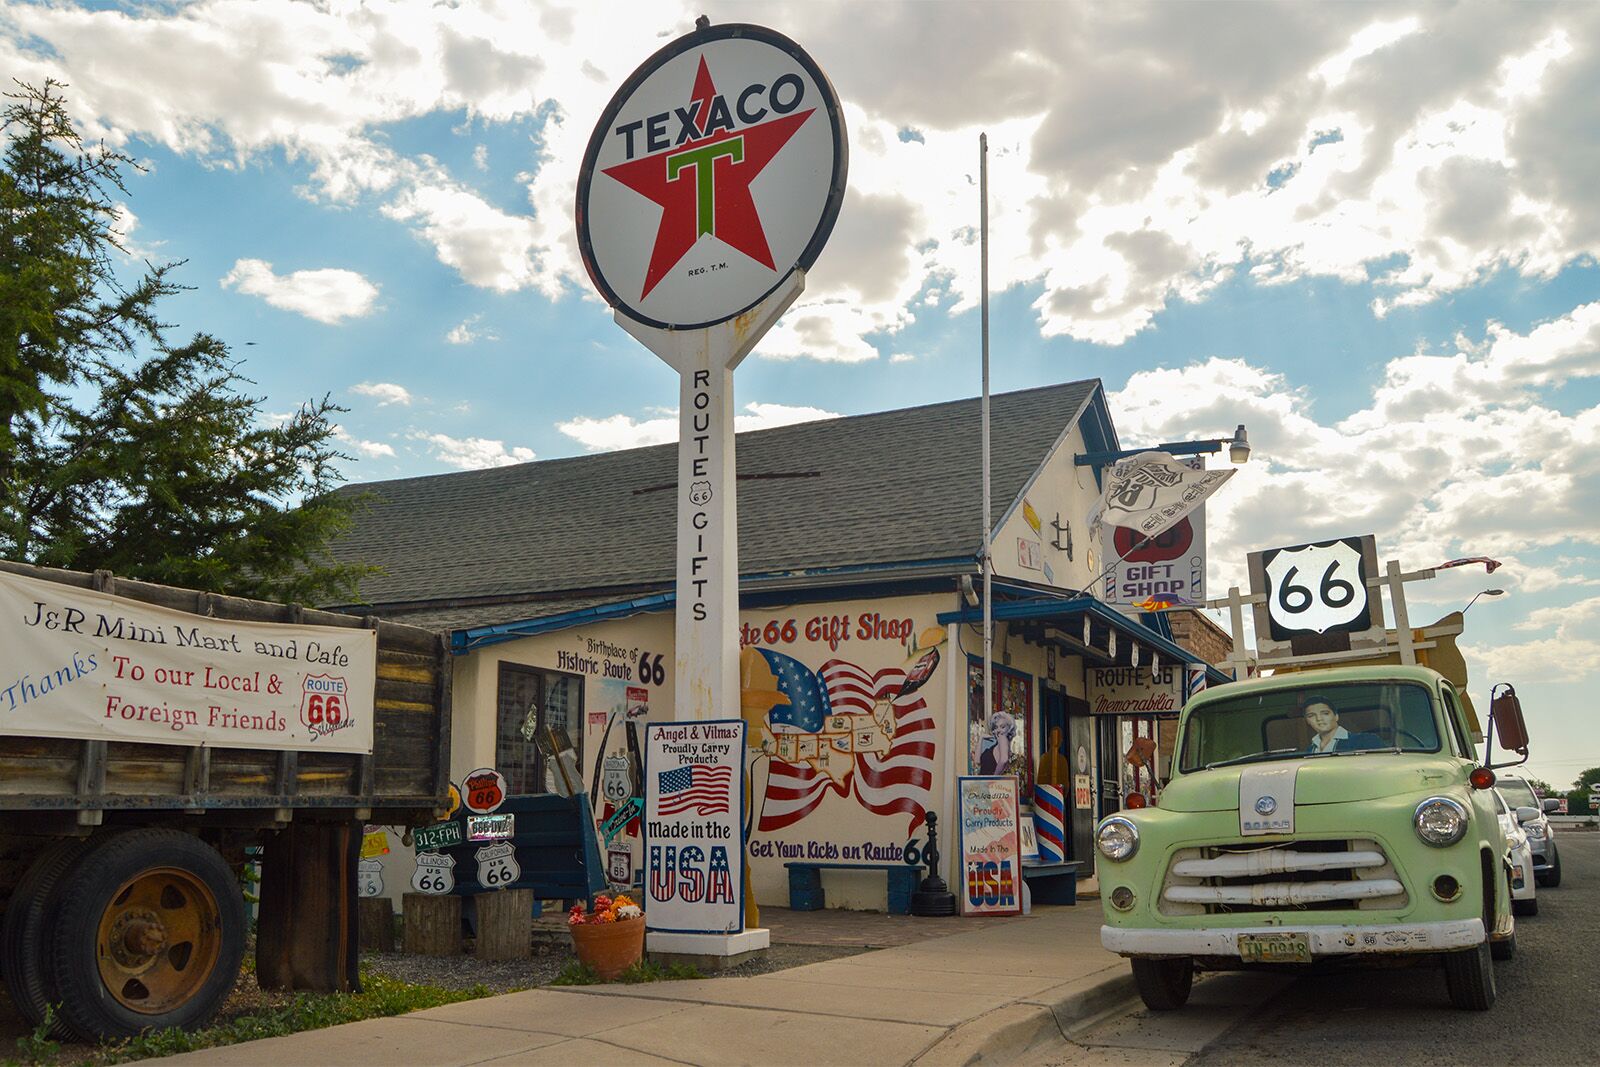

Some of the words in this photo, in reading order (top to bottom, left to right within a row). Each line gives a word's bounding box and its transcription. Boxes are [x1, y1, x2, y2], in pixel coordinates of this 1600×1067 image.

[616, 73, 804, 160] TEXACO
[688, 267, 708, 277] REG.
[694, 370, 710, 476] ROUTE
[693, 491, 709, 502] 66
[691, 512, 709, 621] GIFTS
[1126, 564, 1175, 581] GIFT
[1122, 579, 1185, 598] SHOP
[1279, 559, 1355, 614] 66
[24, 602, 84, 634] J&R
[93, 614, 167, 645] Mini
[175, 625, 241, 653] Mart
[255, 640, 298, 661] and
[305, 642, 349, 668] Cafe
[763, 618, 798, 645] 66
[805, 614, 851, 652] Gift
[856, 613, 914, 647] Shop
[587, 638, 627, 660] Birthplace
[629, 647, 639, 664] of
[113, 655, 145, 682] To
[154, 667, 194, 687] our
[204, 666, 260, 694] Local
[267, 674, 283, 695] &
[556, 650, 599, 675] Historic
[602, 659, 632, 681] Route
[638, 651, 665, 686] 66
[1095, 667, 1144, 687] ROUTE
[1, 650, 98, 711] Thanks
[307, 679, 343, 692] ROUTE
[308, 694, 341, 725] 66
[1095, 692, 1175, 713] Memorabilia
[105, 696, 198, 731] Foreign
[207, 706, 287, 733] Friends
[654, 726, 687, 744] Angel
[690, 726, 700, 739] &
[662, 743, 698, 755] Proudly
[701, 743, 730, 755] Carry
[678, 753, 718, 765] Products
[476, 791, 495, 804] 66
[607, 781, 625, 797] 66
[973, 806, 1003, 817] Proudly
[648, 821, 689, 839] Made
[691, 821, 703, 839] in
[705, 821, 731, 839] the
[984, 818, 1013, 828] Products
[480, 847, 510, 859] CALIFORNIA
[750, 840, 774, 858] Get
[776, 840, 805, 858] Your
[807, 840, 840, 860] Kicks
[842, 845, 861, 861] on
[862, 841, 903, 862] Route
[970, 845, 988, 853] Made
[420, 858, 449, 866] ILLINOIS
[487, 866, 512, 885] 66
[613, 866, 625, 878] 66
[649, 845, 735, 904] USA
[420, 875, 445, 891] 66
[968, 860, 1015, 907] USA
